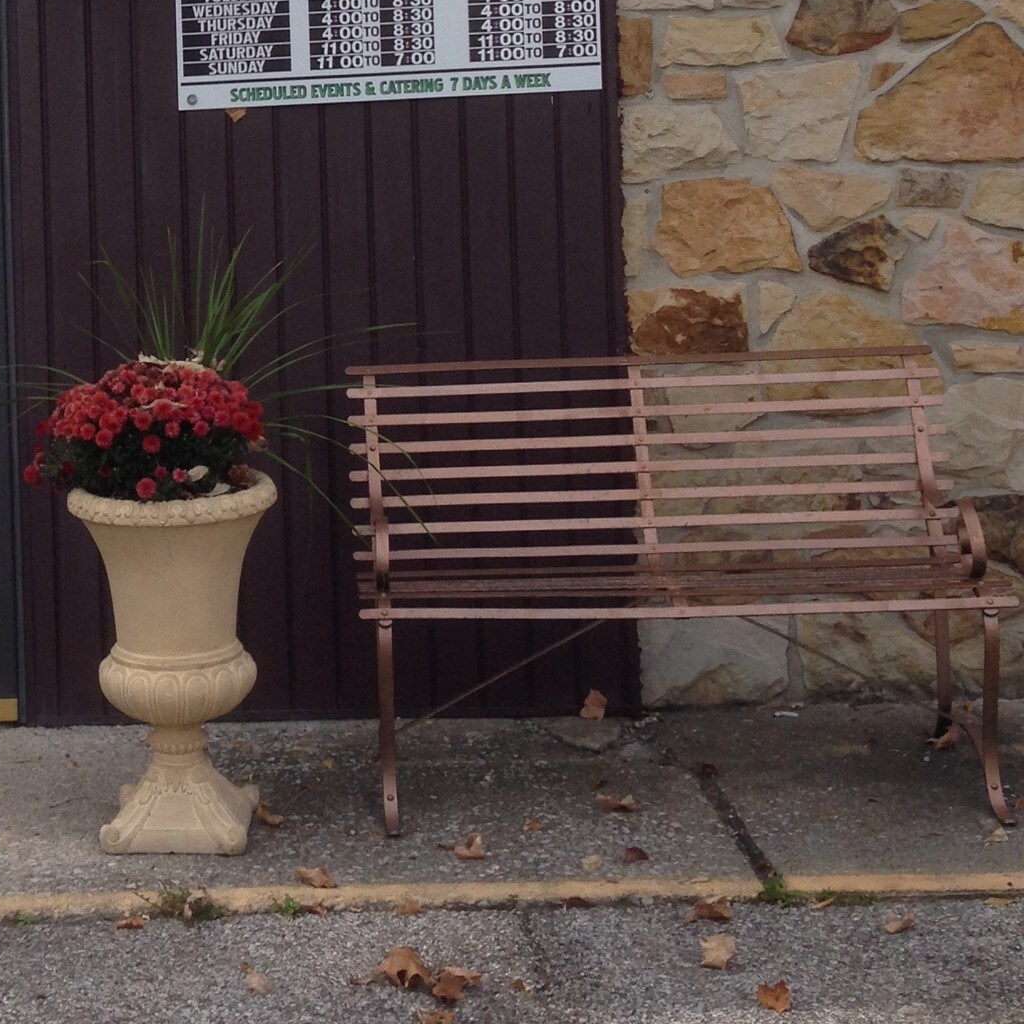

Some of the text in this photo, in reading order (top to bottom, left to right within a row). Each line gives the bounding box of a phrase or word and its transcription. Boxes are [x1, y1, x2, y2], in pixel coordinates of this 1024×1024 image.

[192, 1, 278, 18] WEDNESDAY
[198, 16, 274, 32] THURSDAY
[363, 11, 379, 23] TO
[393, 8, 432, 22] 8:30
[481, 3, 523, 18] 4:00
[524, 3, 541, 14] TO
[554, 0, 595, 14] 8:00
[199, 45, 273, 61] SATURDAY
[364, 40, 380, 52] TO
[394, 36, 433, 51] 8:30
[525, 32, 542, 44] TO
[555, 29, 594, 43] 8:30
[210, 14, 594, 46] FRIDAY 4:00 TO 8:30 4:00 TO 8:30
[208, 60, 265, 75] SUNDAY
[364, 55, 380, 66] TO
[394, 51, 435, 66] 7:00
[526, 47, 542, 59] TO
[556, 43, 597, 58] 7:00
[230, 73, 552, 102] SCHEDULED EVENTS & CATERING 7 DAYS A WEEK
